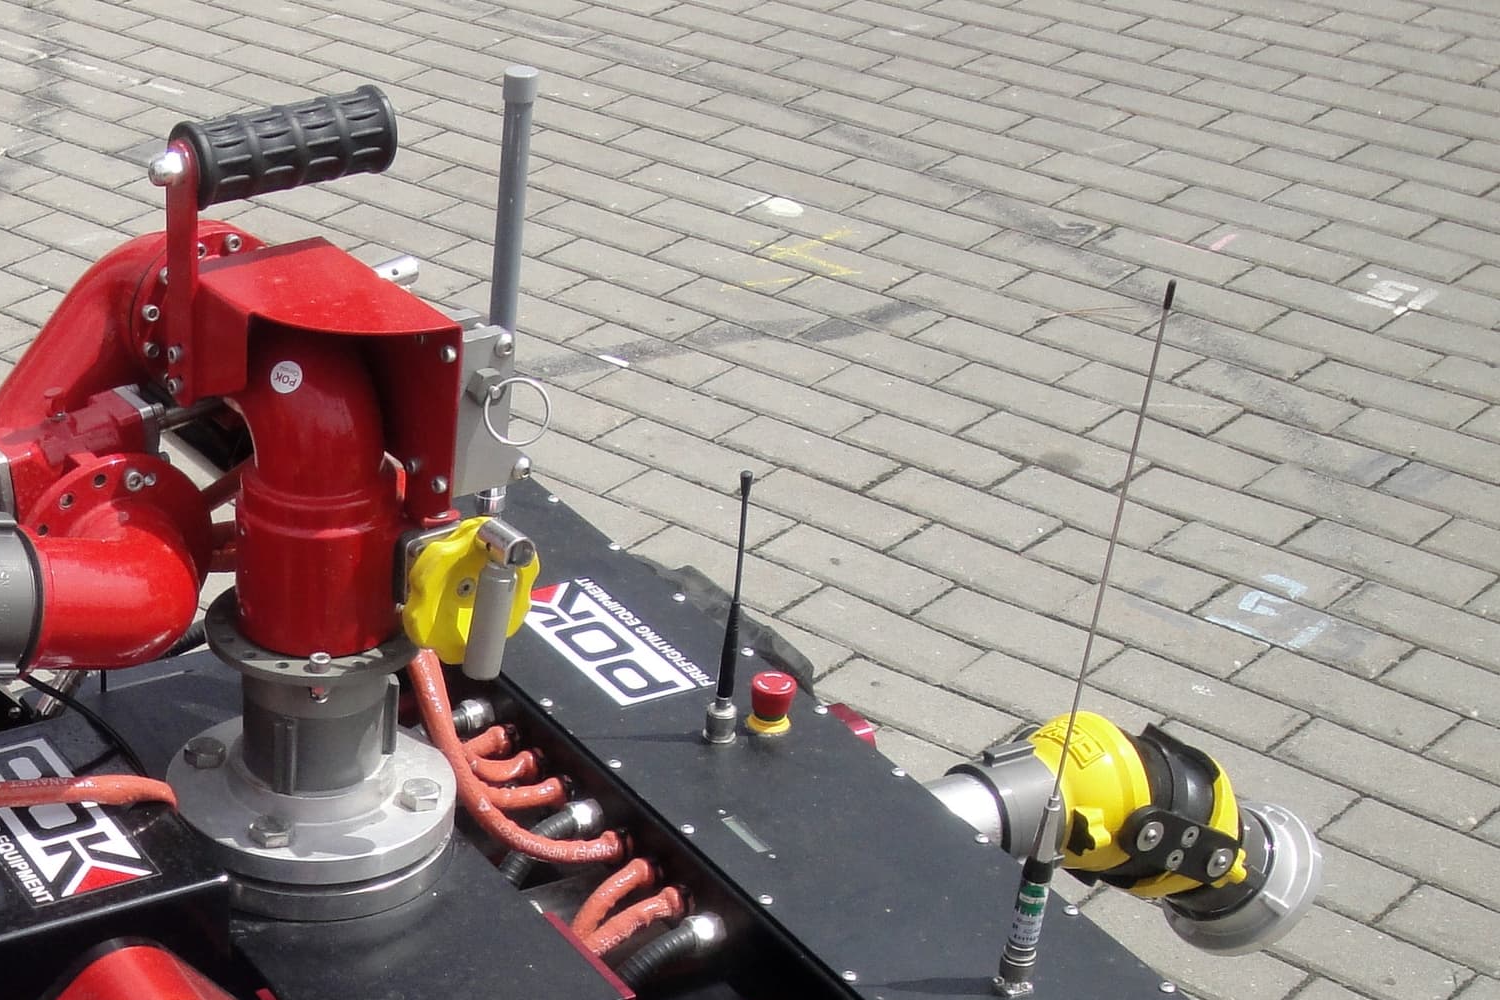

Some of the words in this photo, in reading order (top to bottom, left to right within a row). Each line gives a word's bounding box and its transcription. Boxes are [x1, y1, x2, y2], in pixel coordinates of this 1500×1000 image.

[275, 372, 297, 387] POK
[575, 577, 641, 628] EQUIPMENT
[532, 582, 680, 698] POK
[634, 625, 716, 687] FIREFIGHTING
